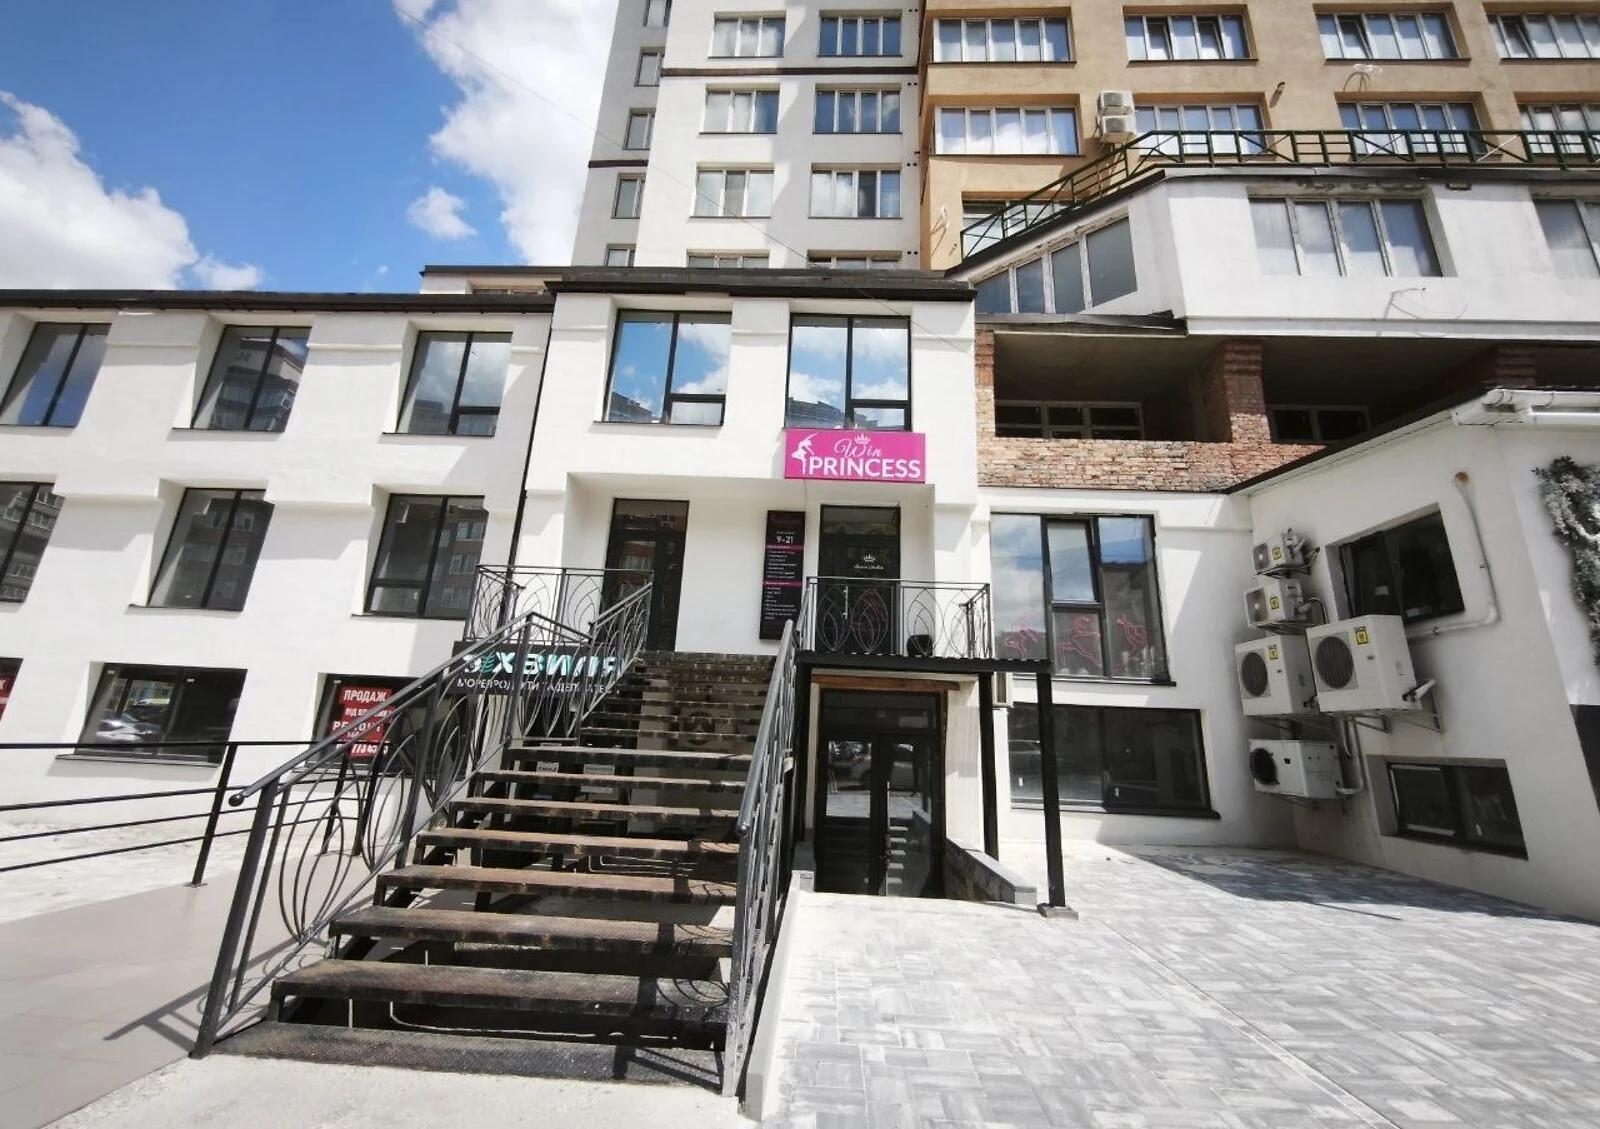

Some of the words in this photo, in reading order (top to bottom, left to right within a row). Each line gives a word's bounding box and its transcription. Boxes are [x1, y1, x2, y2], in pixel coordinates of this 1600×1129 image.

[834, 438, 882, 459] Win
[808, 456, 921, 479] PRINCESS
[343, 689, 387, 703] ПРОДАЖ
